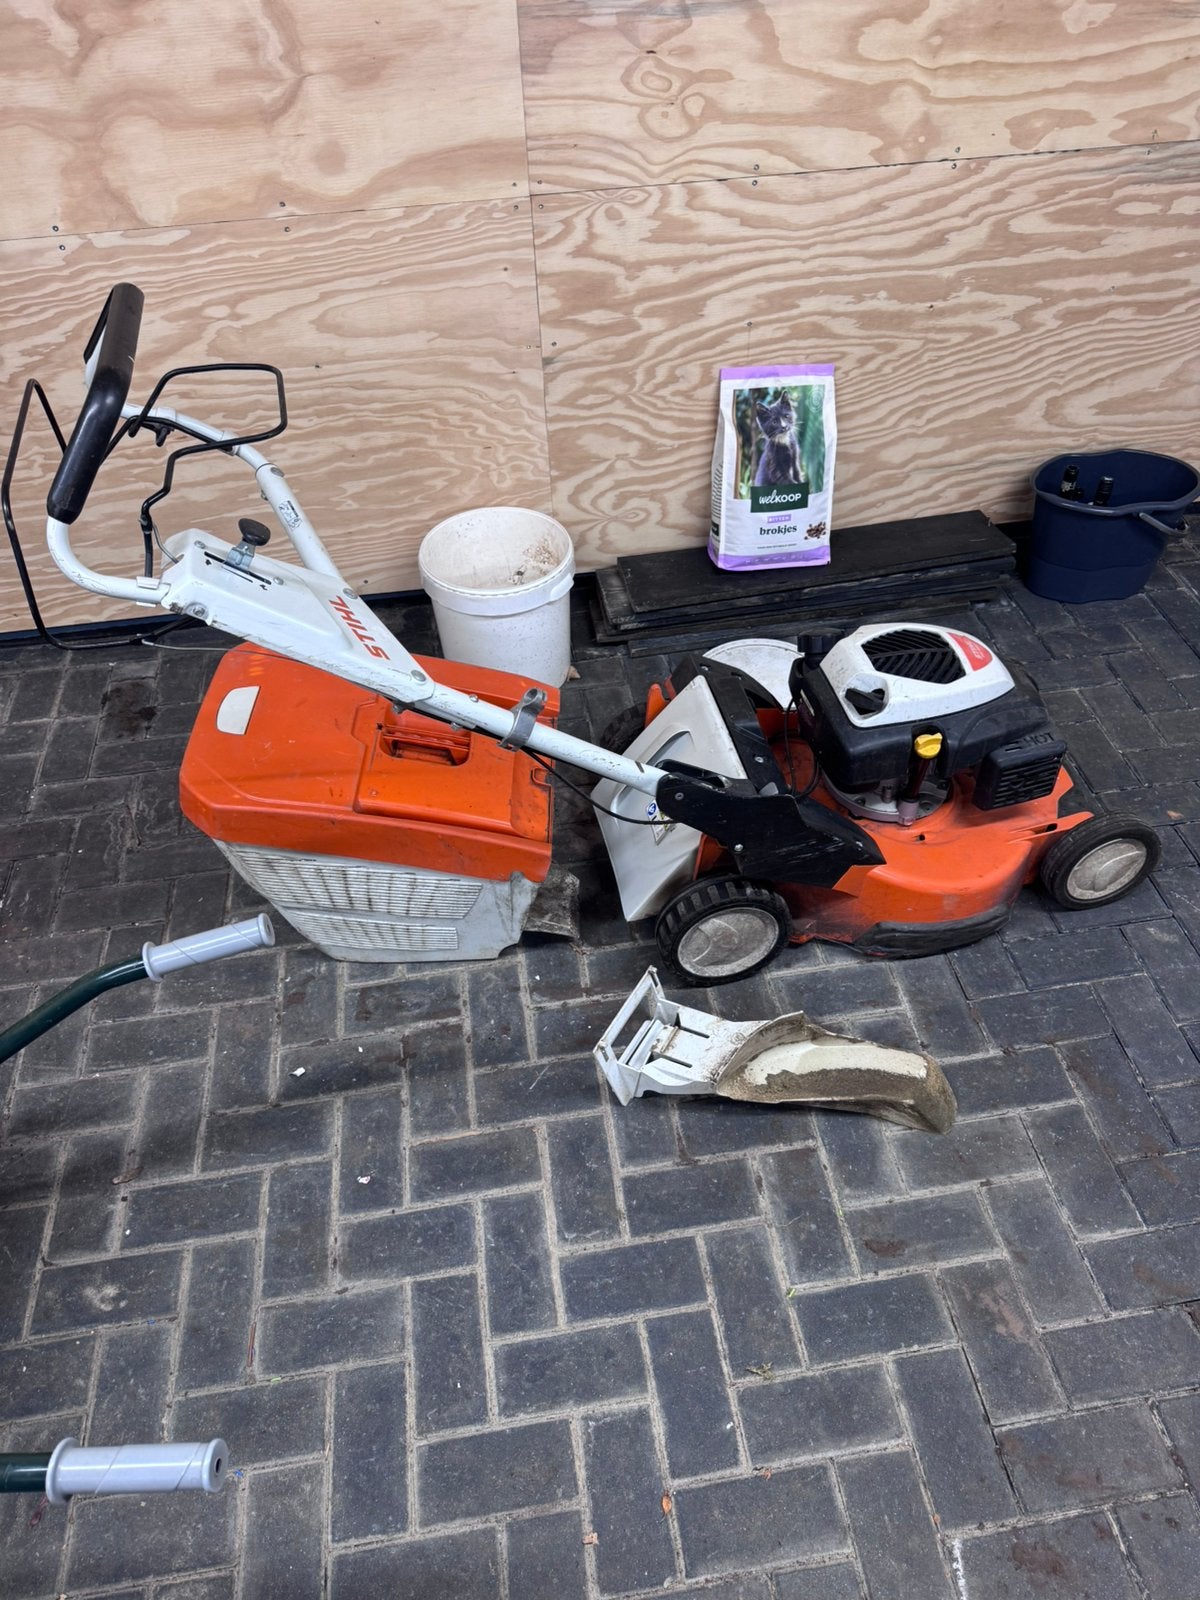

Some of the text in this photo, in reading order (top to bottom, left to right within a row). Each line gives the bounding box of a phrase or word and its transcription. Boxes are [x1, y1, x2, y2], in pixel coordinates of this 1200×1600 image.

[760, 525, 797, 536] brokjes
[328, 595, 391, 660] STIHL
[1023, 732, 1055, 748] HOT
